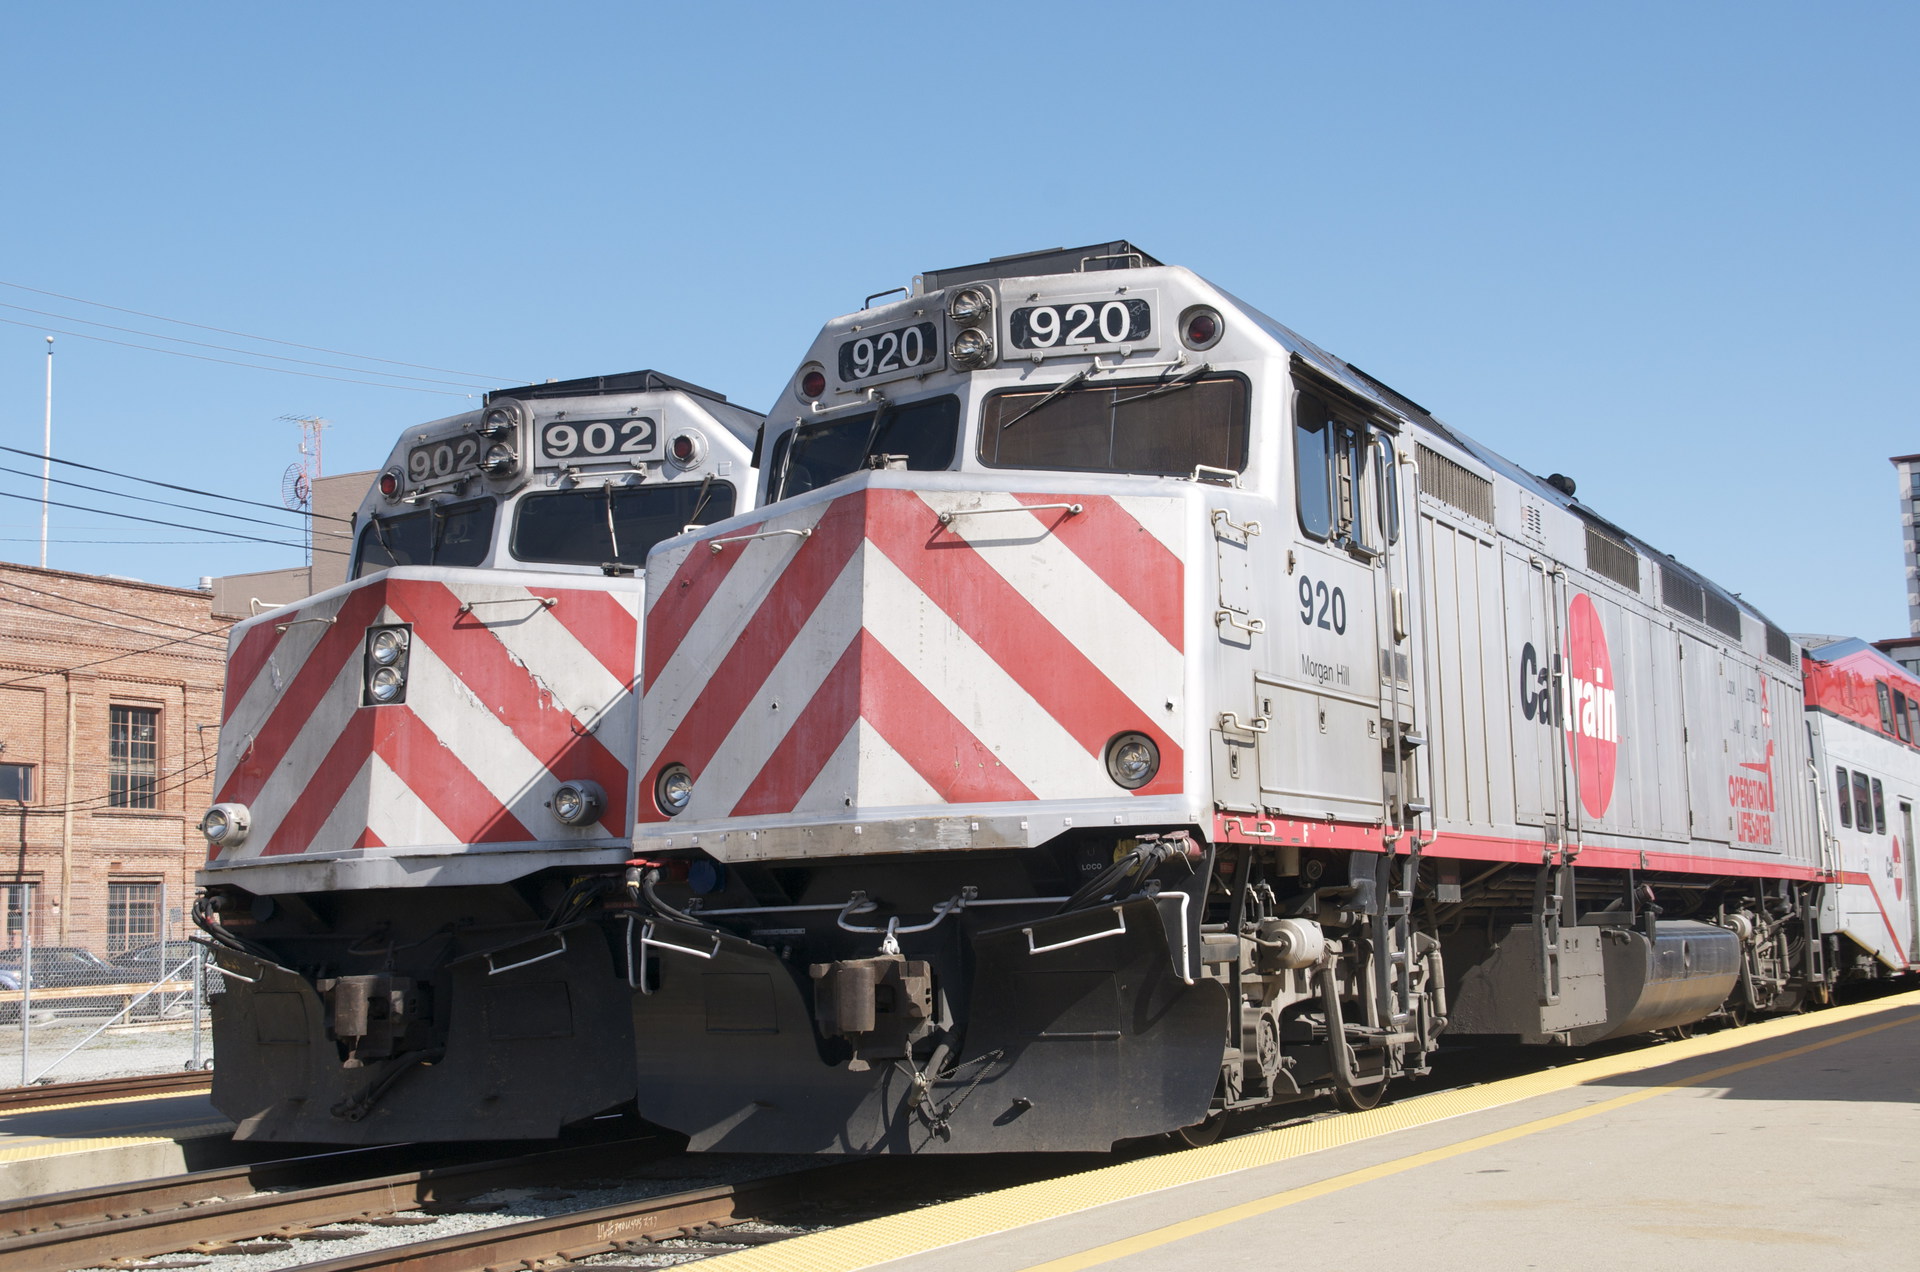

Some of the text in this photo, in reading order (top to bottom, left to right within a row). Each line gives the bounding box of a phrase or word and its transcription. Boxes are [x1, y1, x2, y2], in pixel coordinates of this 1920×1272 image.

[1029, 302, 1131, 348] 920
[852, 327, 923, 379] 920
[546, 420, 653, 457] 902
[410, 439, 477, 482] 902
[1299, 575, 1346, 636] 920
[1301, 653, 1350, 686] Morgan Hill
[1520, 641, 1617, 744] Caltrain
[1728, 774, 1768, 812] OPERATION
[1081, 863, 1102, 871] LOCO
